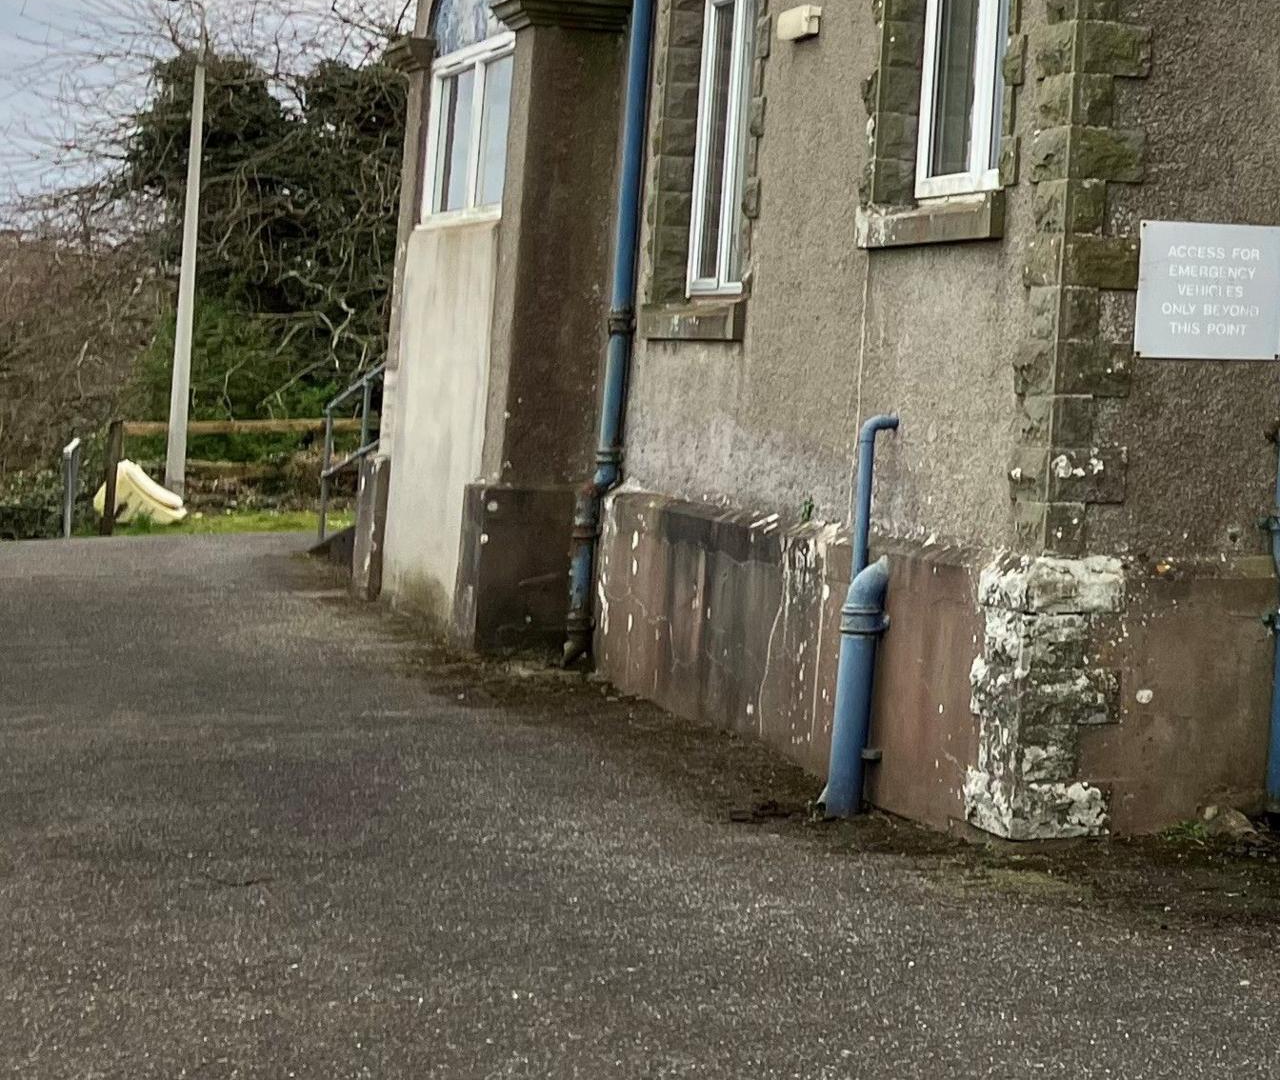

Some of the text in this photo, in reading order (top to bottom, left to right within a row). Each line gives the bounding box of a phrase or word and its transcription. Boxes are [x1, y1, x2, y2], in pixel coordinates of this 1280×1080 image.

[1168, 245, 1260, 261] ACCESS FOR
[1169, 265, 1256, 280] EMERGENCY
[1178, 285, 1244, 297] VEHICLES
[1162, 302, 1259, 317] ONLY BEYOND
[1169, 322, 1247, 335] THIS POINT
